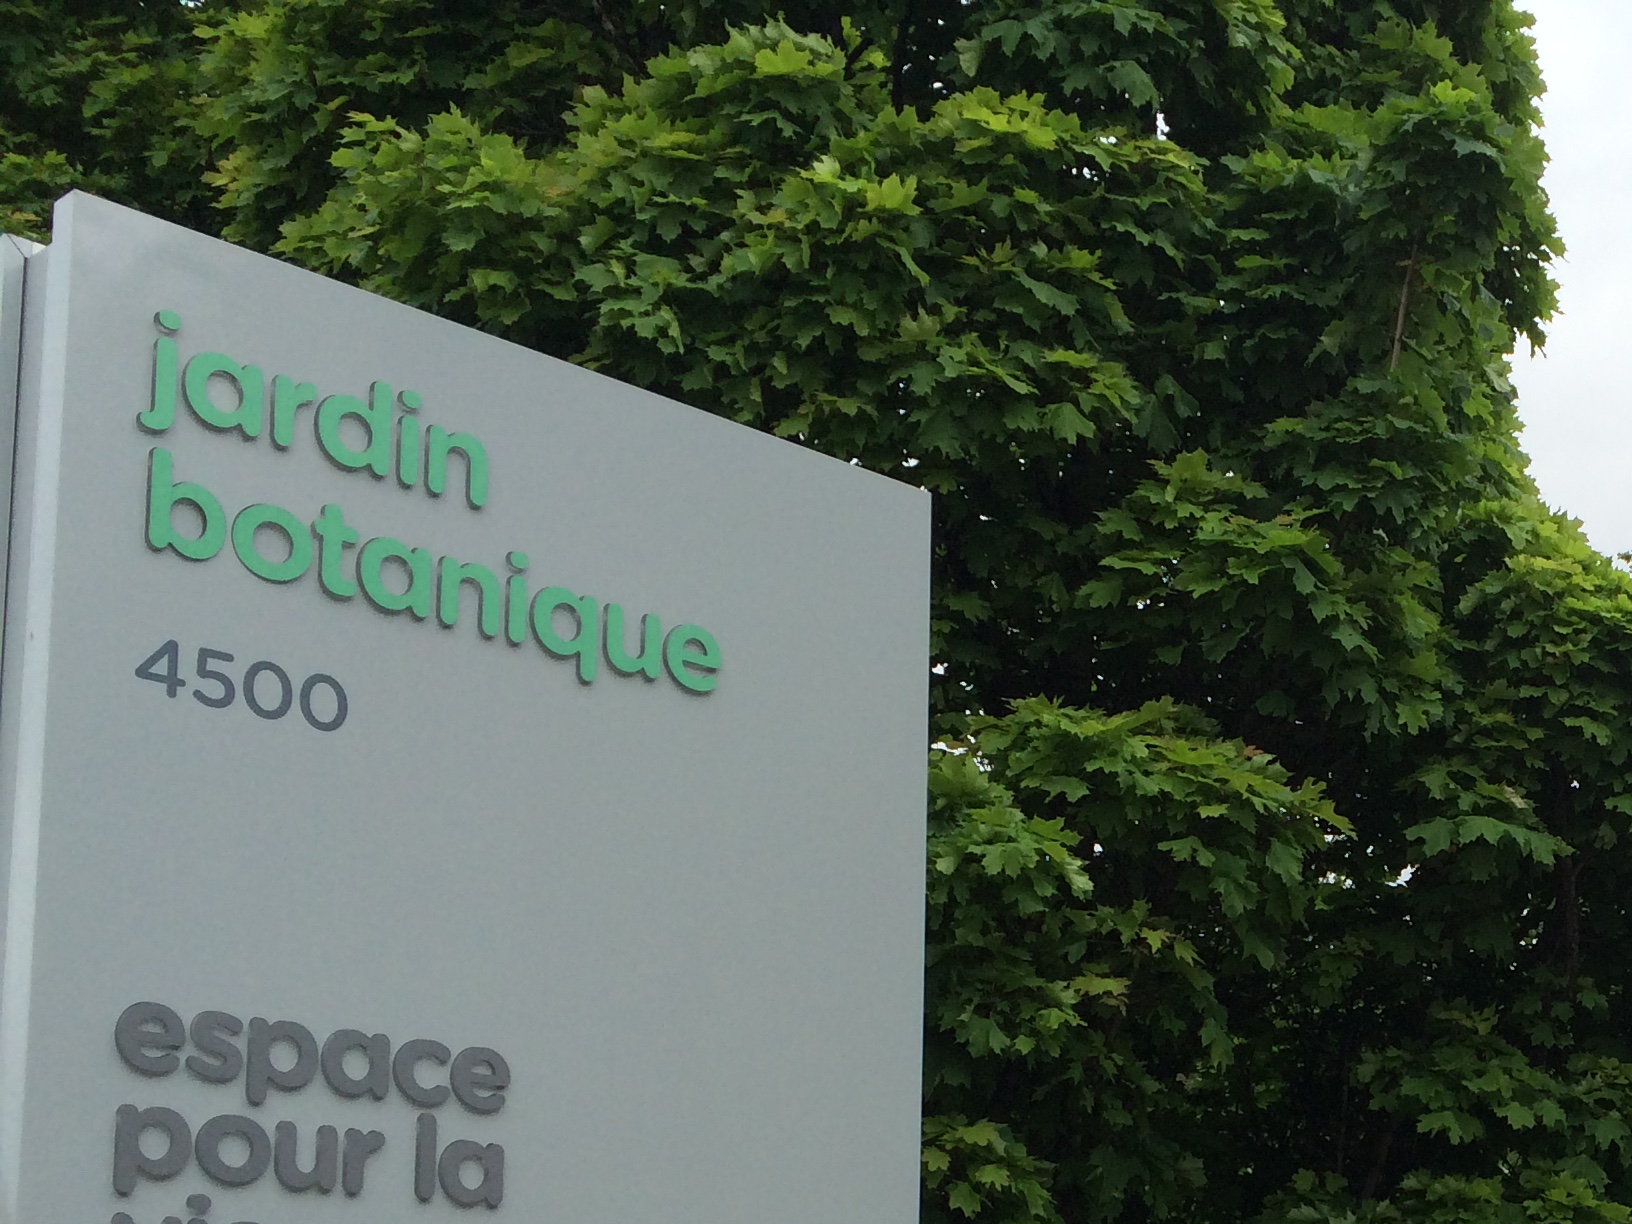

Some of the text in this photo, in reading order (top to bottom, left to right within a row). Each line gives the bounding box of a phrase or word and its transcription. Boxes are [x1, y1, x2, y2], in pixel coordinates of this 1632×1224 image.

[136, 309, 489, 510] jardin
[144, 447, 723, 694] botanique
[134, 640, 350, 732] 4500
[113, 1000, 512, 1115] espace
[112, 1103, 506, 1210] pour la
